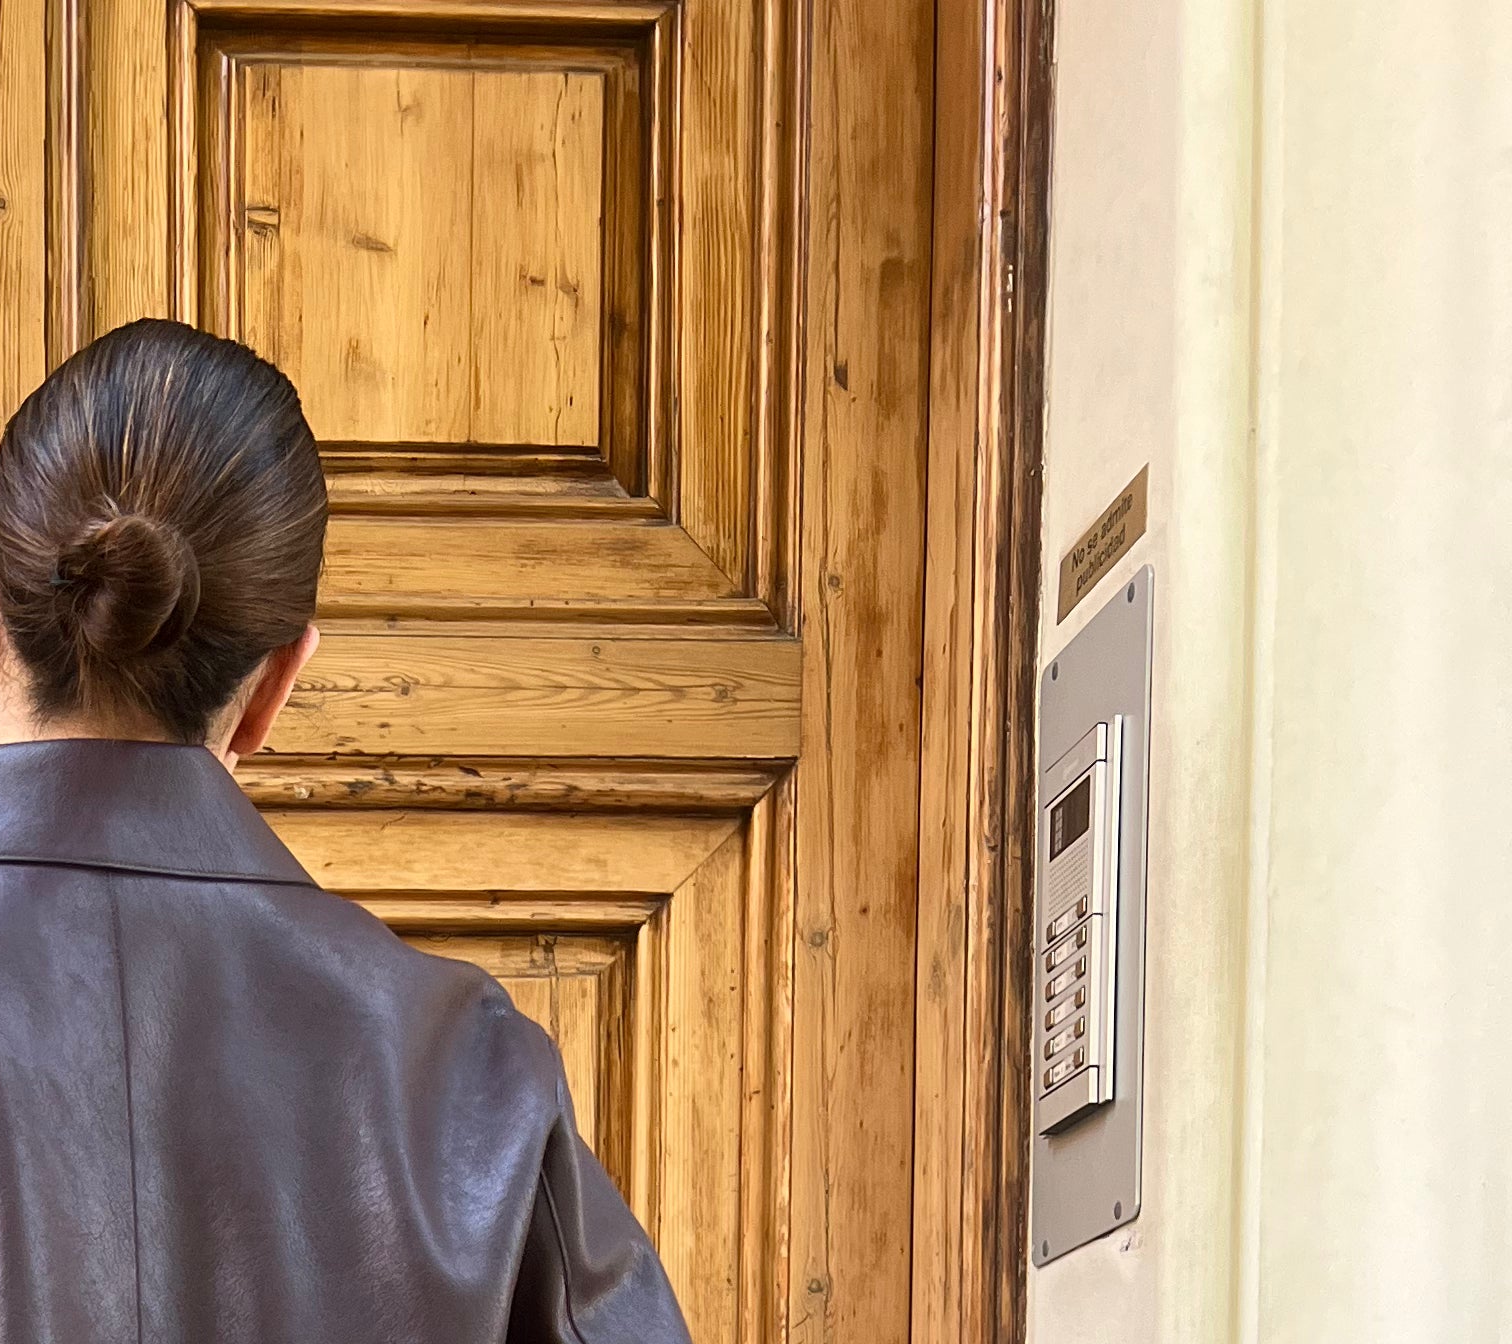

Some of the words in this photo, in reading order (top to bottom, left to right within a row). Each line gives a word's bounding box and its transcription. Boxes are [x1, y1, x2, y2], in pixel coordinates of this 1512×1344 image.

[1071, 547, 1085, 573] No
[1087, 532, 1099, 556] se
[1100, 493, 1134, 541] admite
[1075, 522, 1127, 598] publicidad
